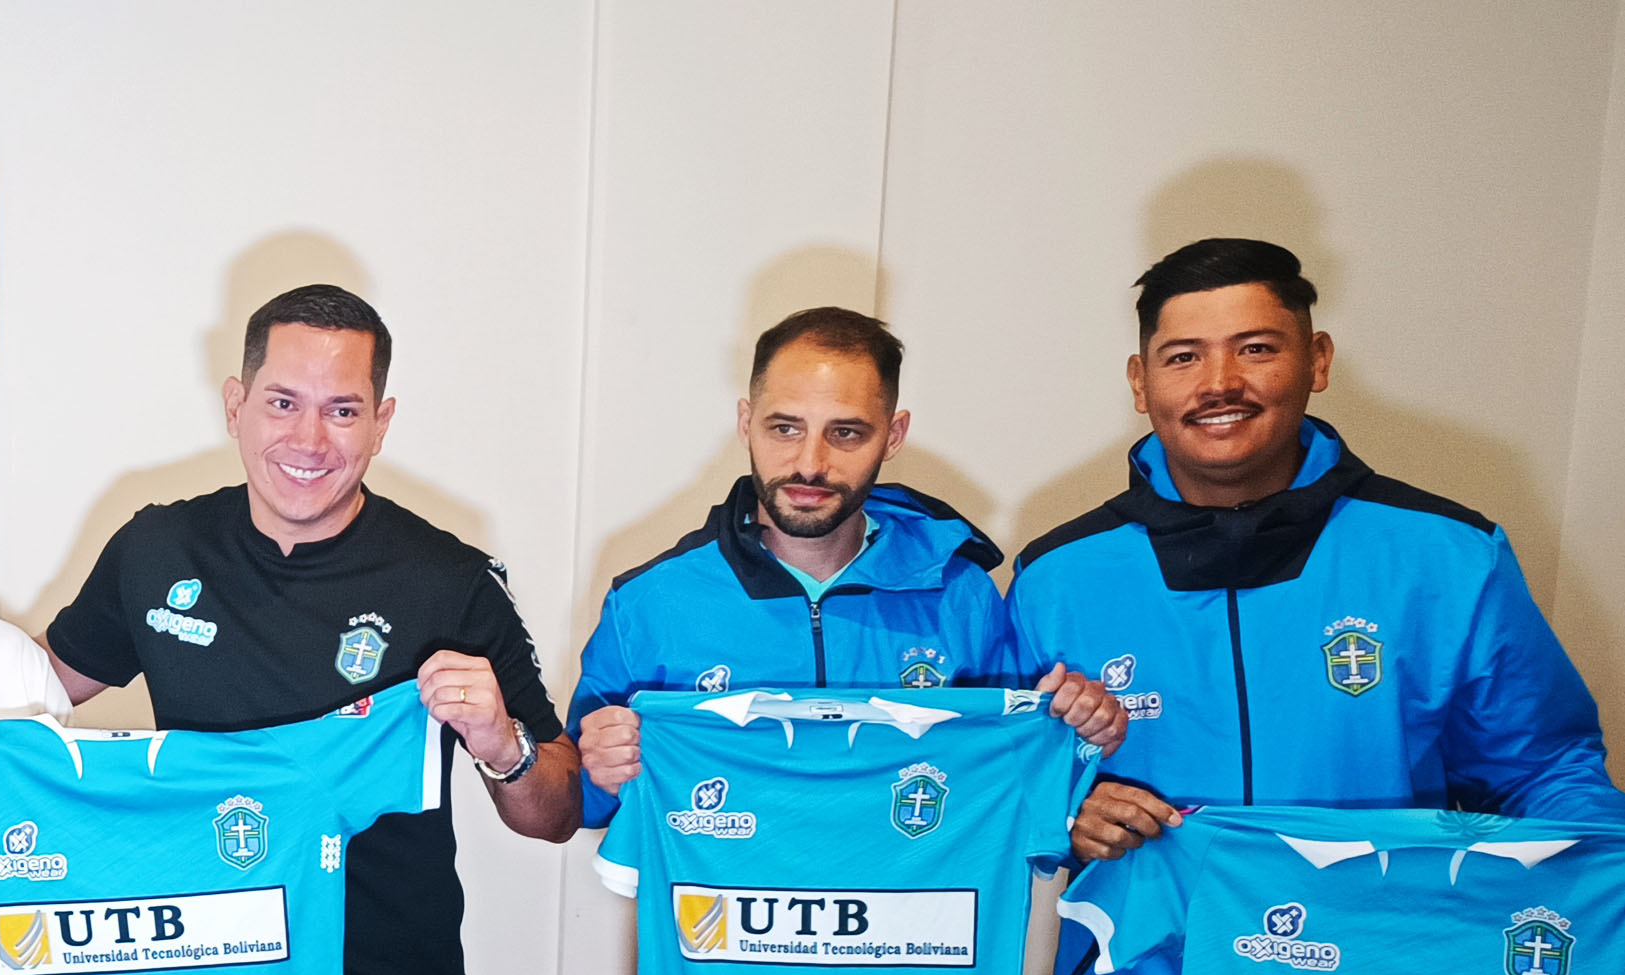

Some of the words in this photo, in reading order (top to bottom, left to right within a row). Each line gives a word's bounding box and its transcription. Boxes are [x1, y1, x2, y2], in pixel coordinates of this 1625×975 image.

[54, 904, 185, 947] UTB
[736, 896, 869, 936] UTB
[63, 949, 138, 965] Universidad
[144, 944, 220, 963] Tecnológica
[223, 939, 282, 956] Boliviana
[739, 940, 817, 955] Universidad
[822, 941, 901, 959] Tecnológica
[906, 942, 968, 957] Boliviana
